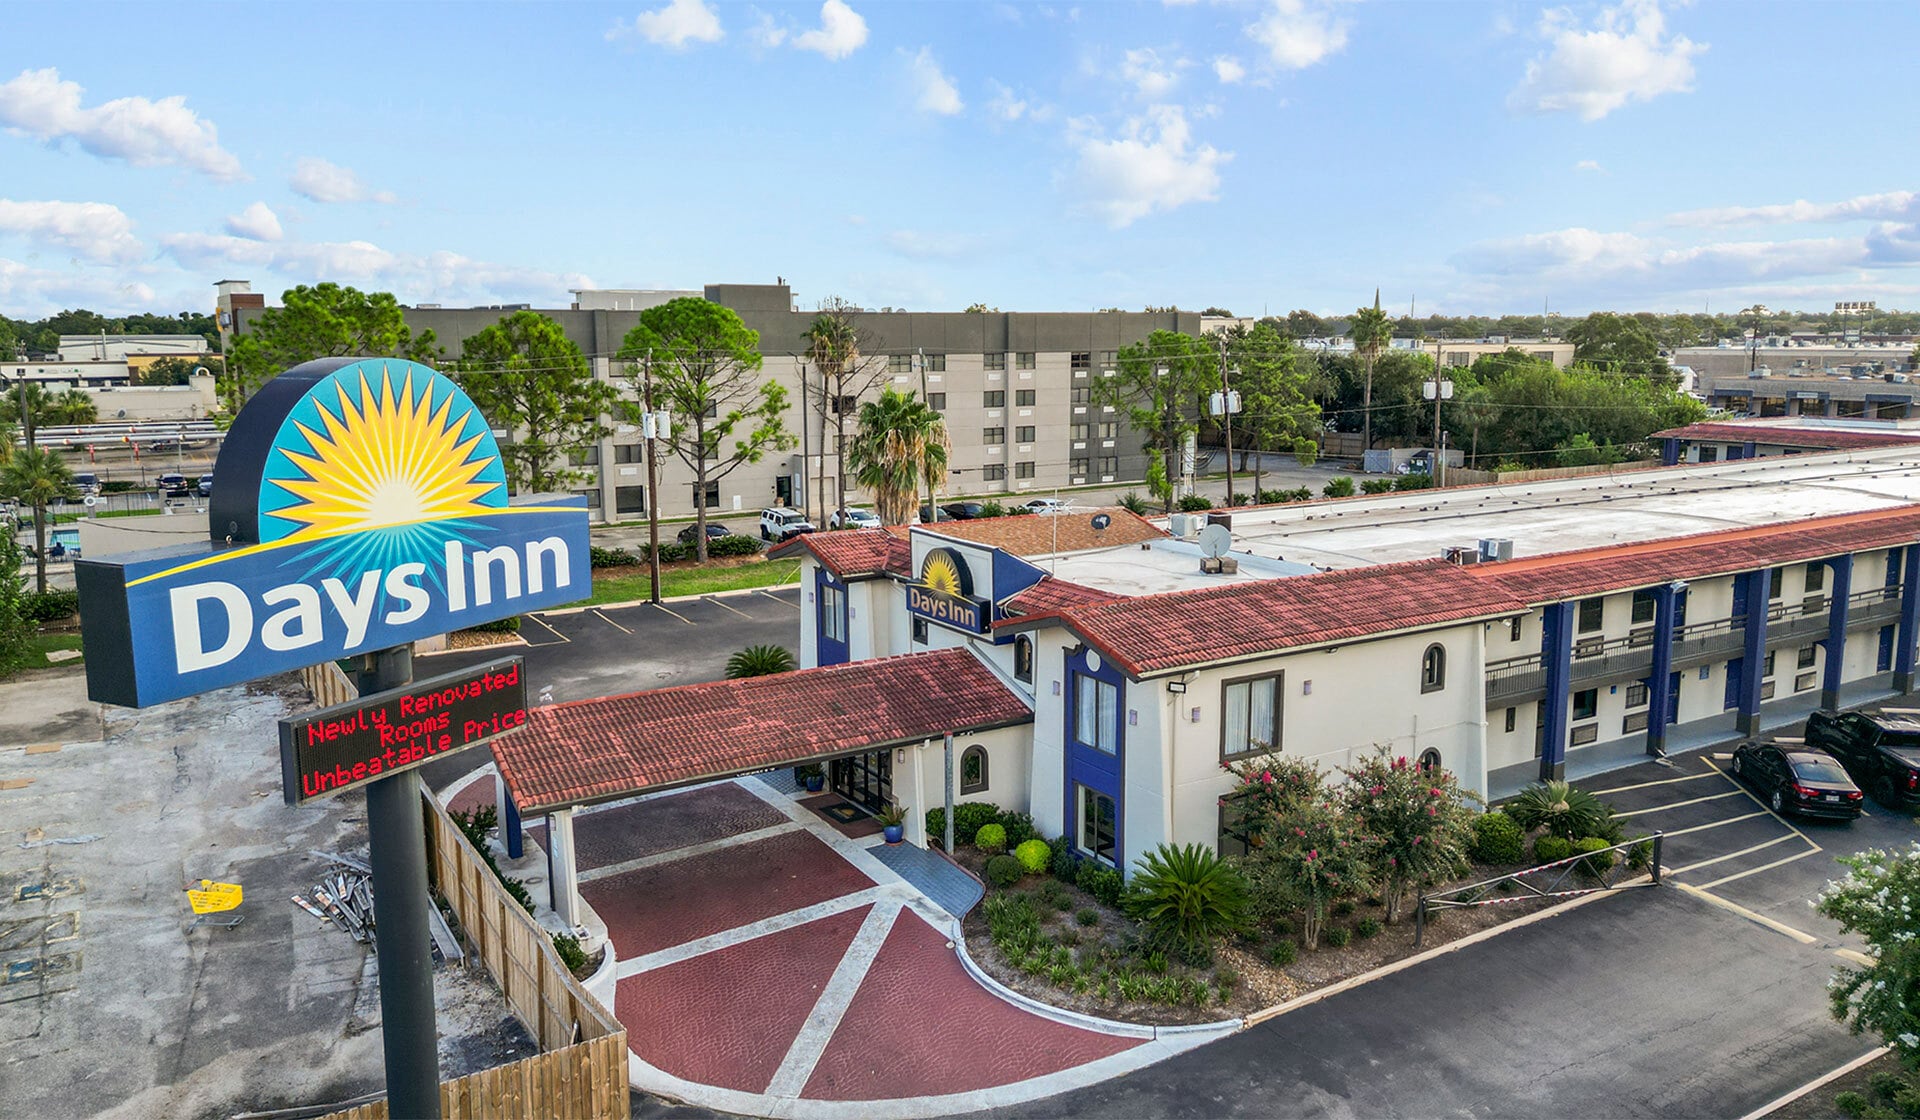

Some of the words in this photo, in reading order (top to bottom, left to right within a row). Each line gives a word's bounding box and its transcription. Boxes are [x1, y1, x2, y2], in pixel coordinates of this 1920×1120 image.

[169, 562, 431, 675] Days
[444, 535, 571, 613] Inn
[910, 587, 947, 617] Days
[949, 599, 976, 628] Inn
[307, 708, 387, 747] Newly
[400, 664, 518, 718] Renovated
[378, 711, 450, 748] Rooms
[303, 734, 452, 797] Unbeatable
[463, 709, 527, 743] Price
